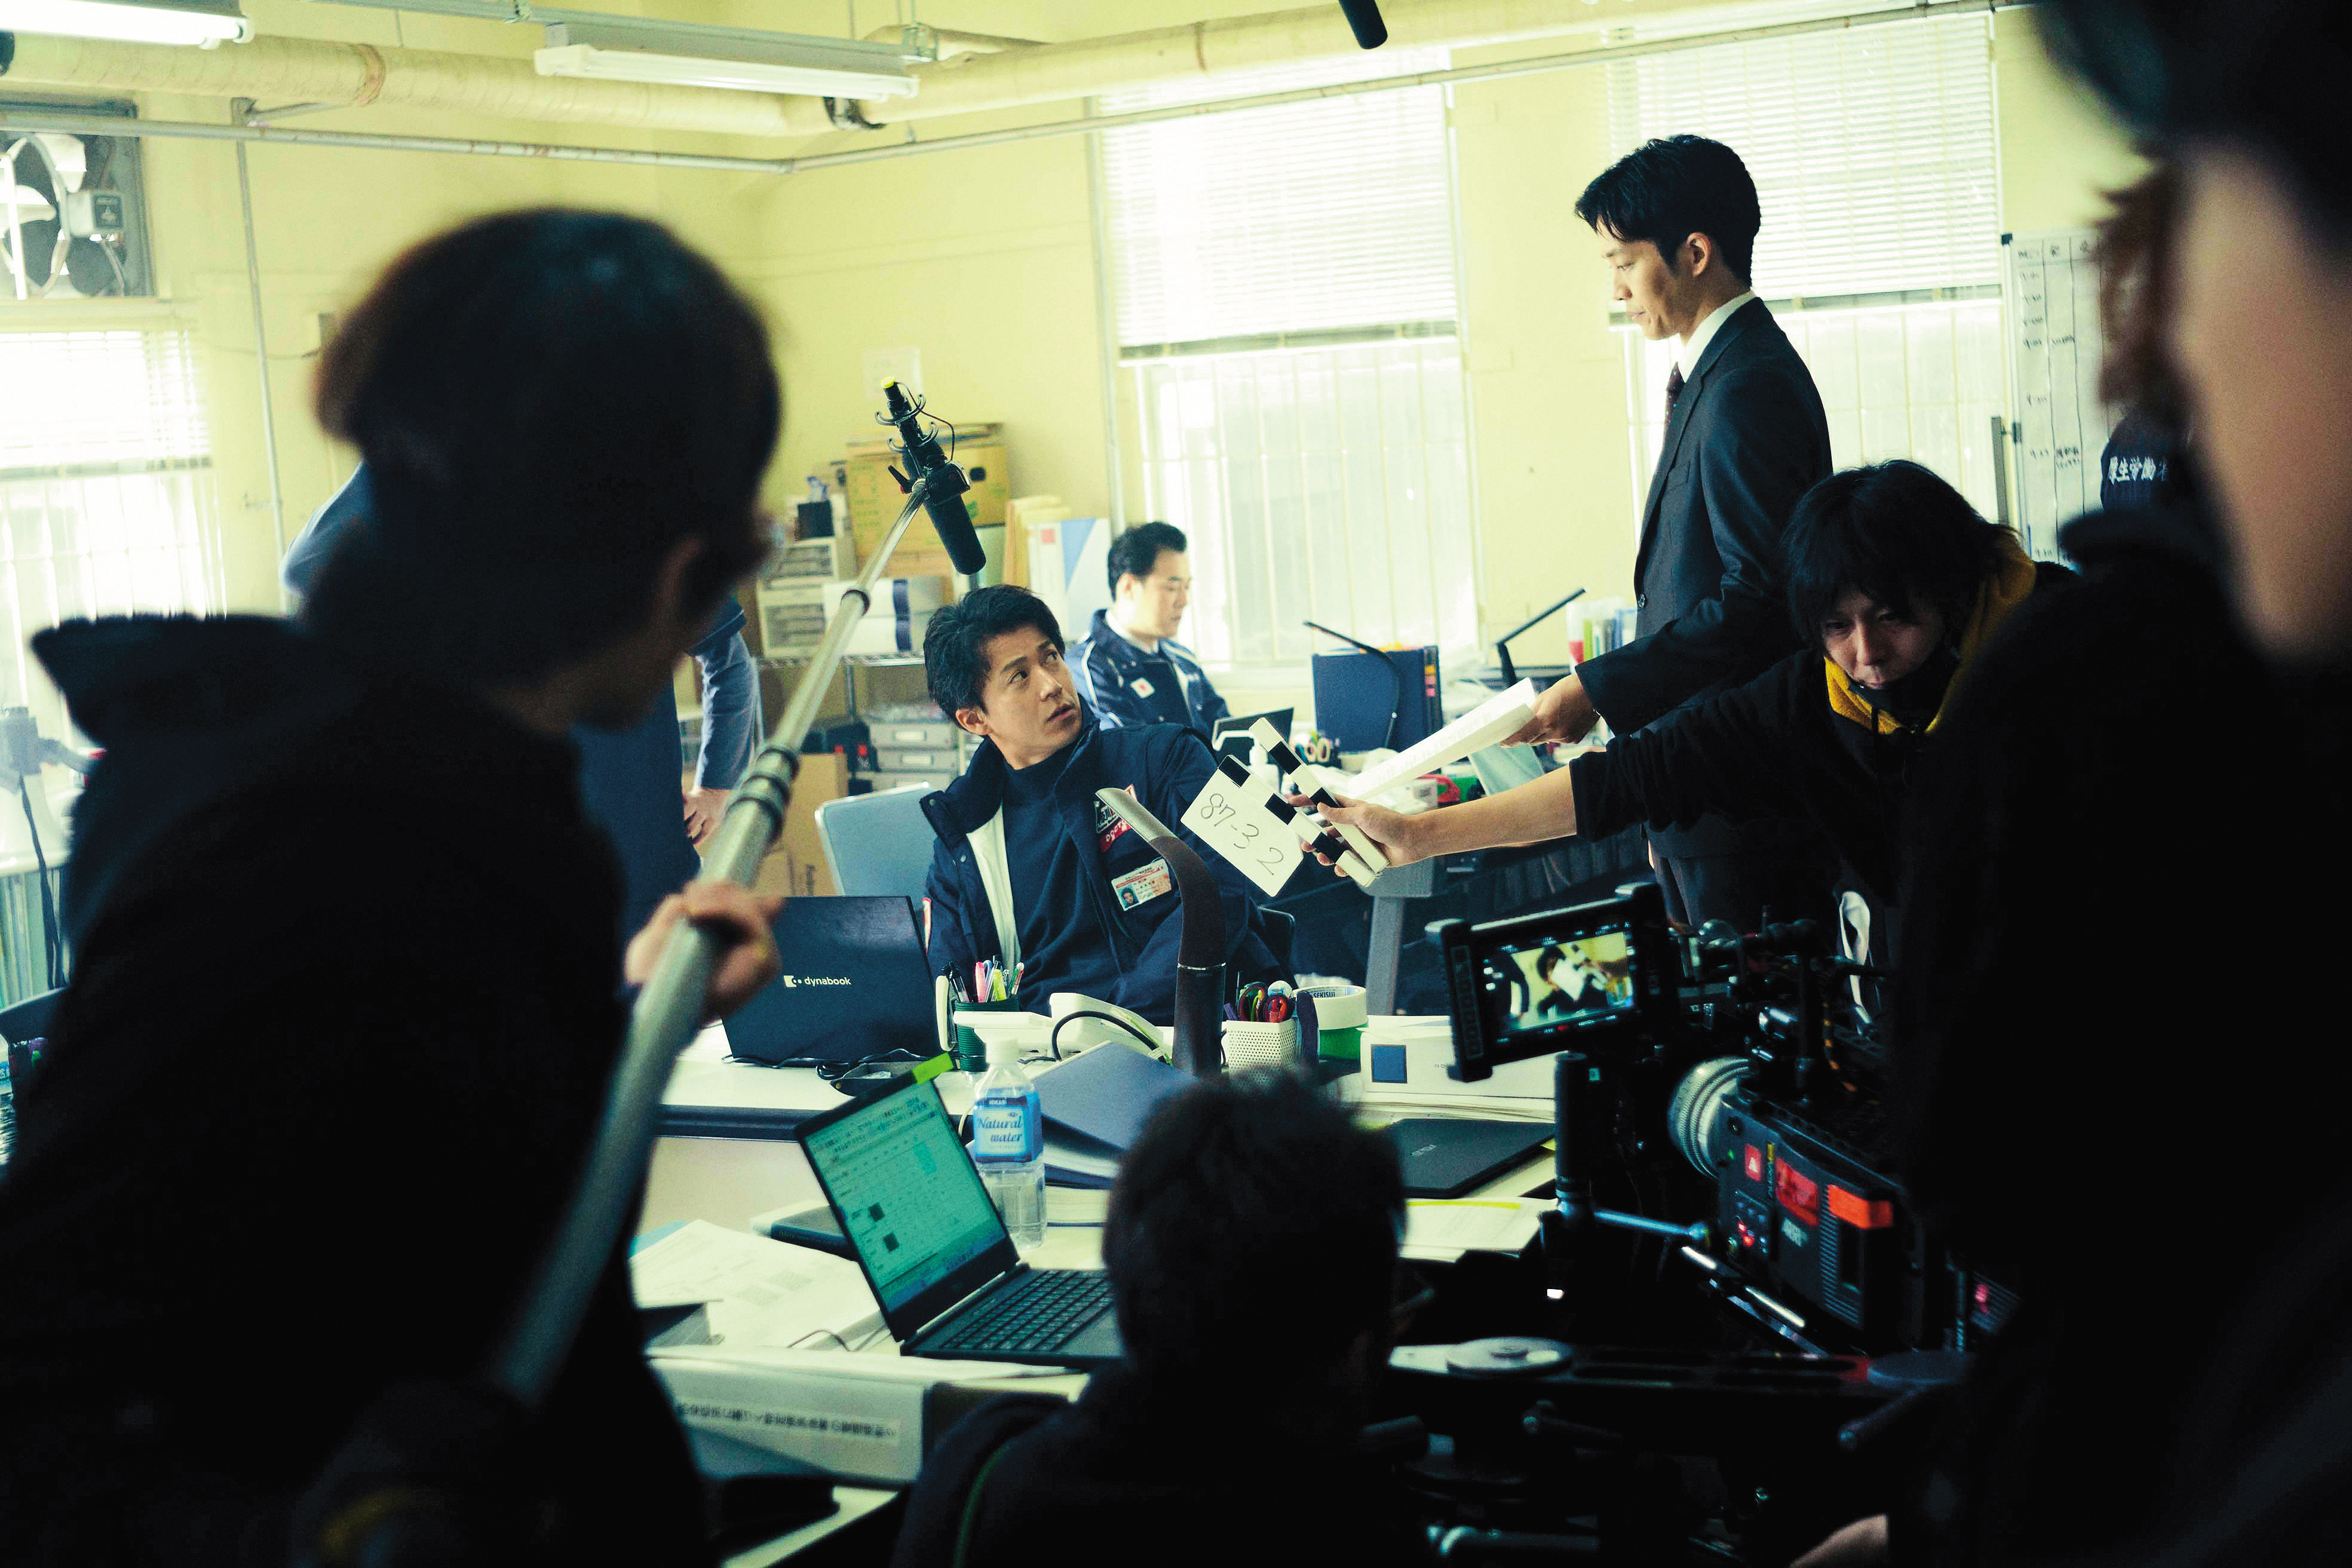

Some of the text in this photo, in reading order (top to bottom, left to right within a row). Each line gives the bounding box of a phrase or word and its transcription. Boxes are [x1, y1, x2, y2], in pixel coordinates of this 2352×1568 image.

[2108, 455, 2168, 485] 厚生労働
[804, 977, 851, 986] dynabook
[978, 1115, 1023, 1128] Natural
[991, 1133, 1023, 1142] water
